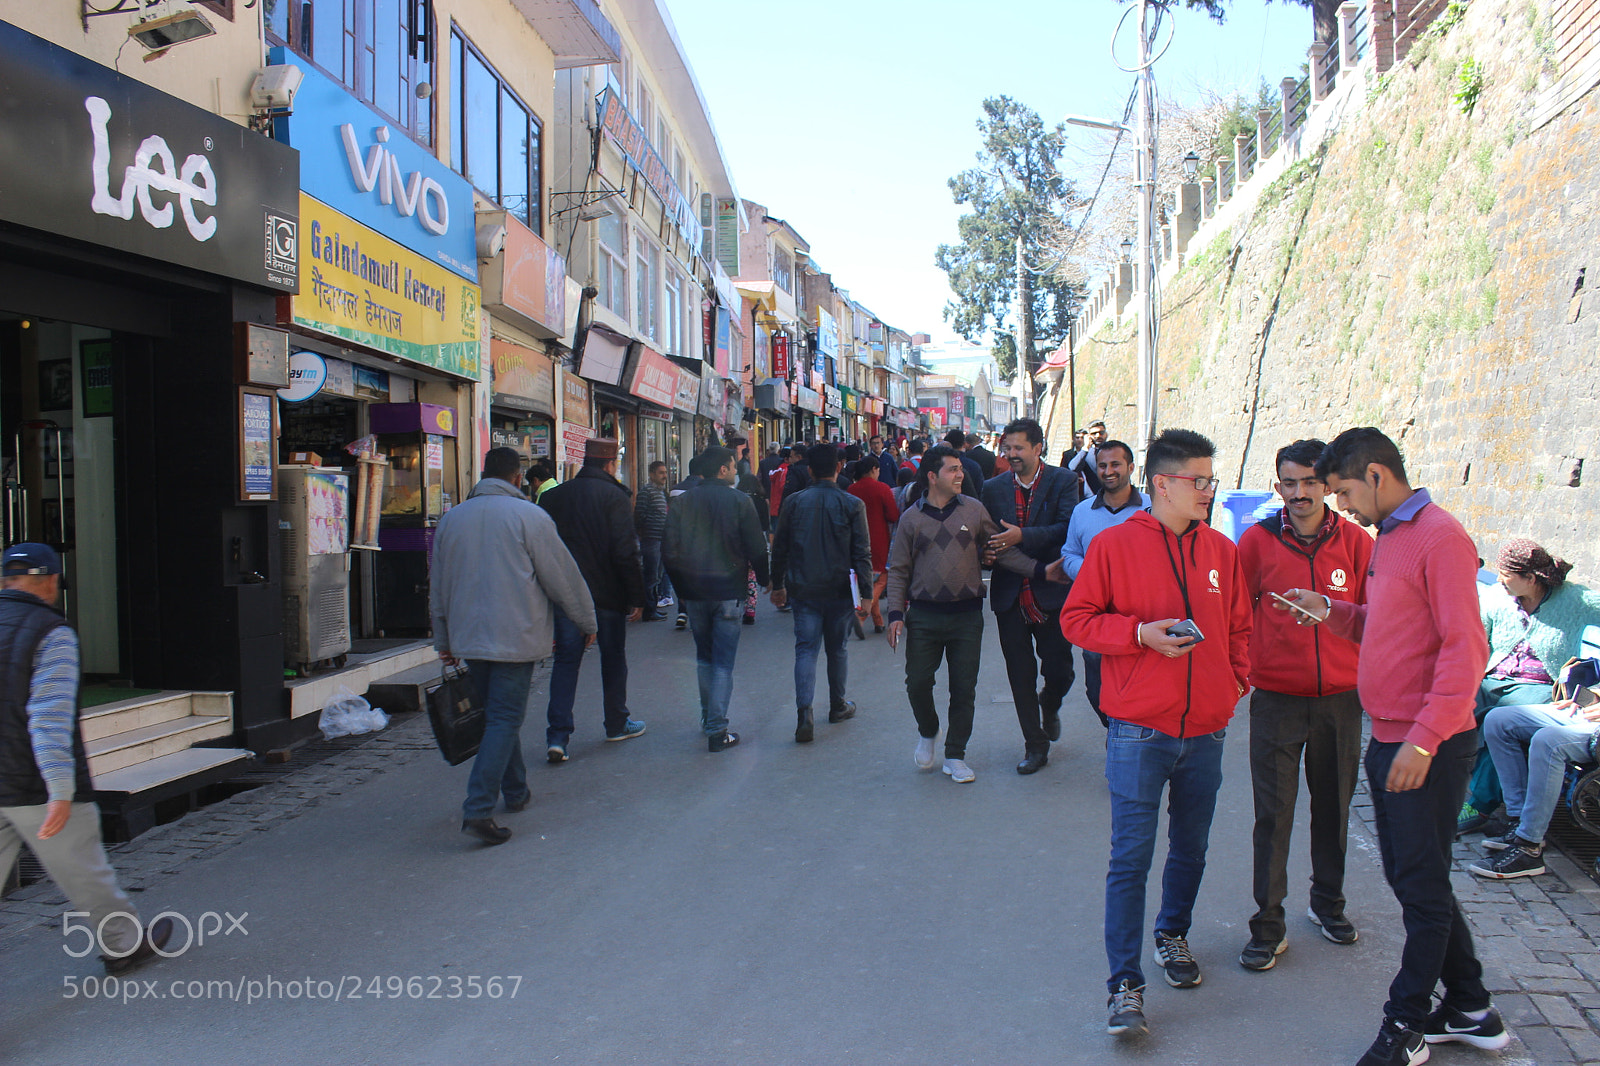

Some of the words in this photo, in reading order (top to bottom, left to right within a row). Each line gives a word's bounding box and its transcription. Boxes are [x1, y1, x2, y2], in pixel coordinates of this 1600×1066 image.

[85, 96, 217, 241] Lee
[340, 123, 449, 236] vivo
[267, 273, 282, 284] Since
[282, 276, 295, 287] 1873
[311, 219, 399, 295] Gaindamull
[404, 266, 446, 322] Hemraj
[364, 289, 402, 337] हेमराज
[290, 369, 317, 378] aytm
[661, 411, 670, 420] AID
